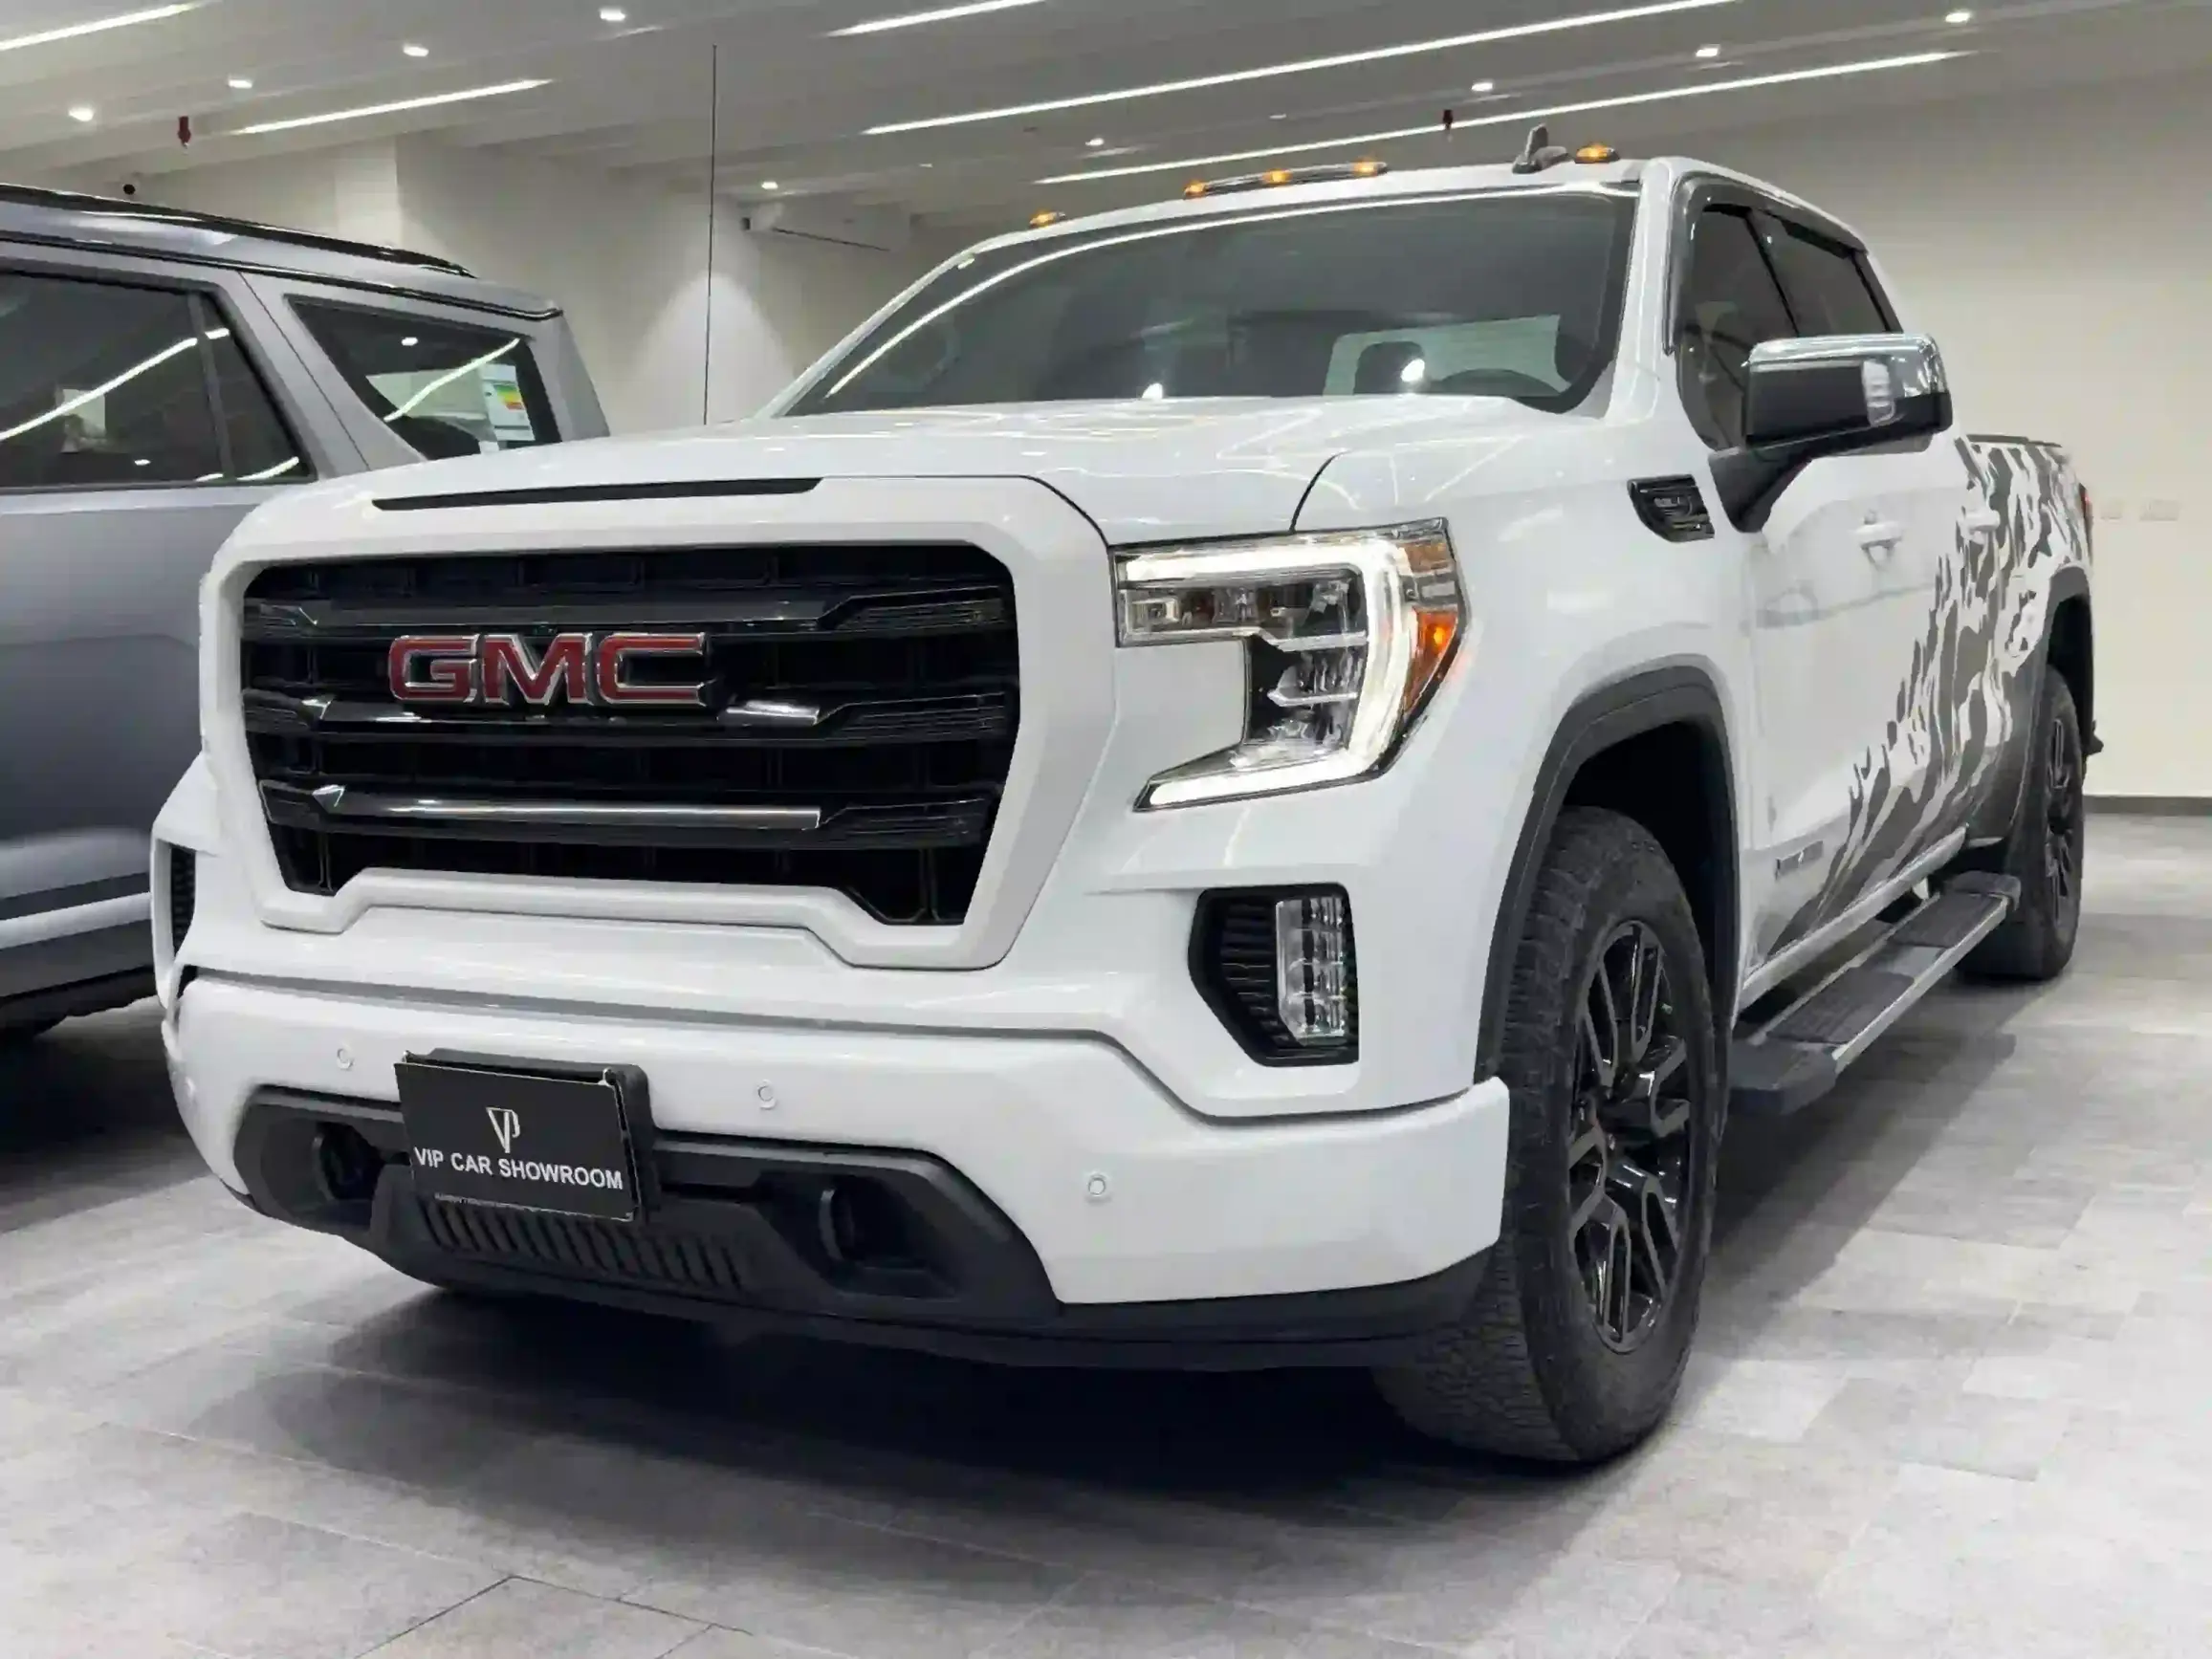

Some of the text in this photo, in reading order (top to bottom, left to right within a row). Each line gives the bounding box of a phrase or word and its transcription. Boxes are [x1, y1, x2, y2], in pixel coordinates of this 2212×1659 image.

[387, 632, 709, 707] GMC
[414, 1146, 624, 1190] VIP CAR SHOWROOM
